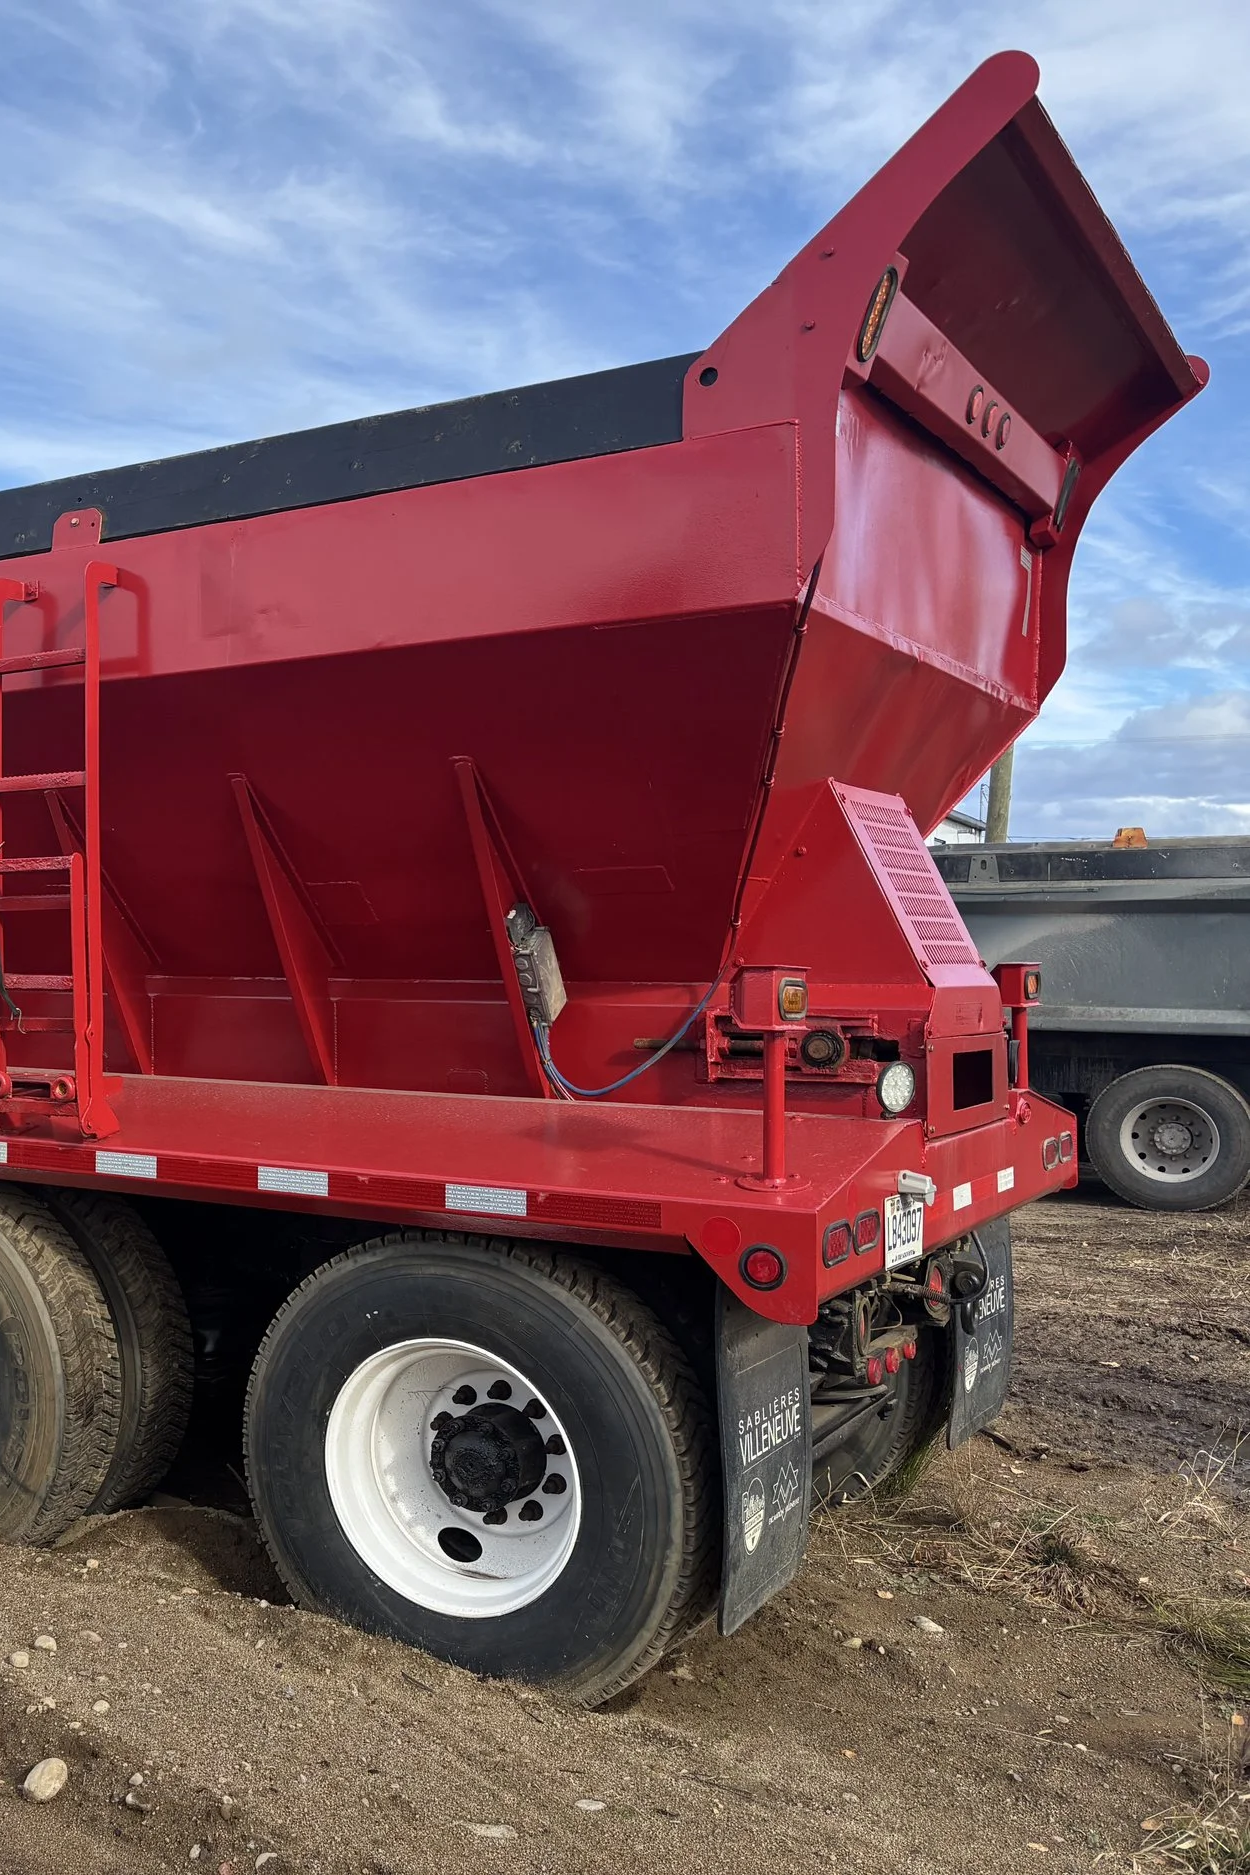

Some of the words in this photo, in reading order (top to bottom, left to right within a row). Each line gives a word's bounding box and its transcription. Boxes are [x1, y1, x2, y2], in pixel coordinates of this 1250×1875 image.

[887, 1206, 922, 1251] L843097
[978, 1286, 1006, 1320] ENEUVE
[738, 1387, 800, 1435] SABLIÈRES
[739, 1402, 801, 1467] VILLENEUVE
